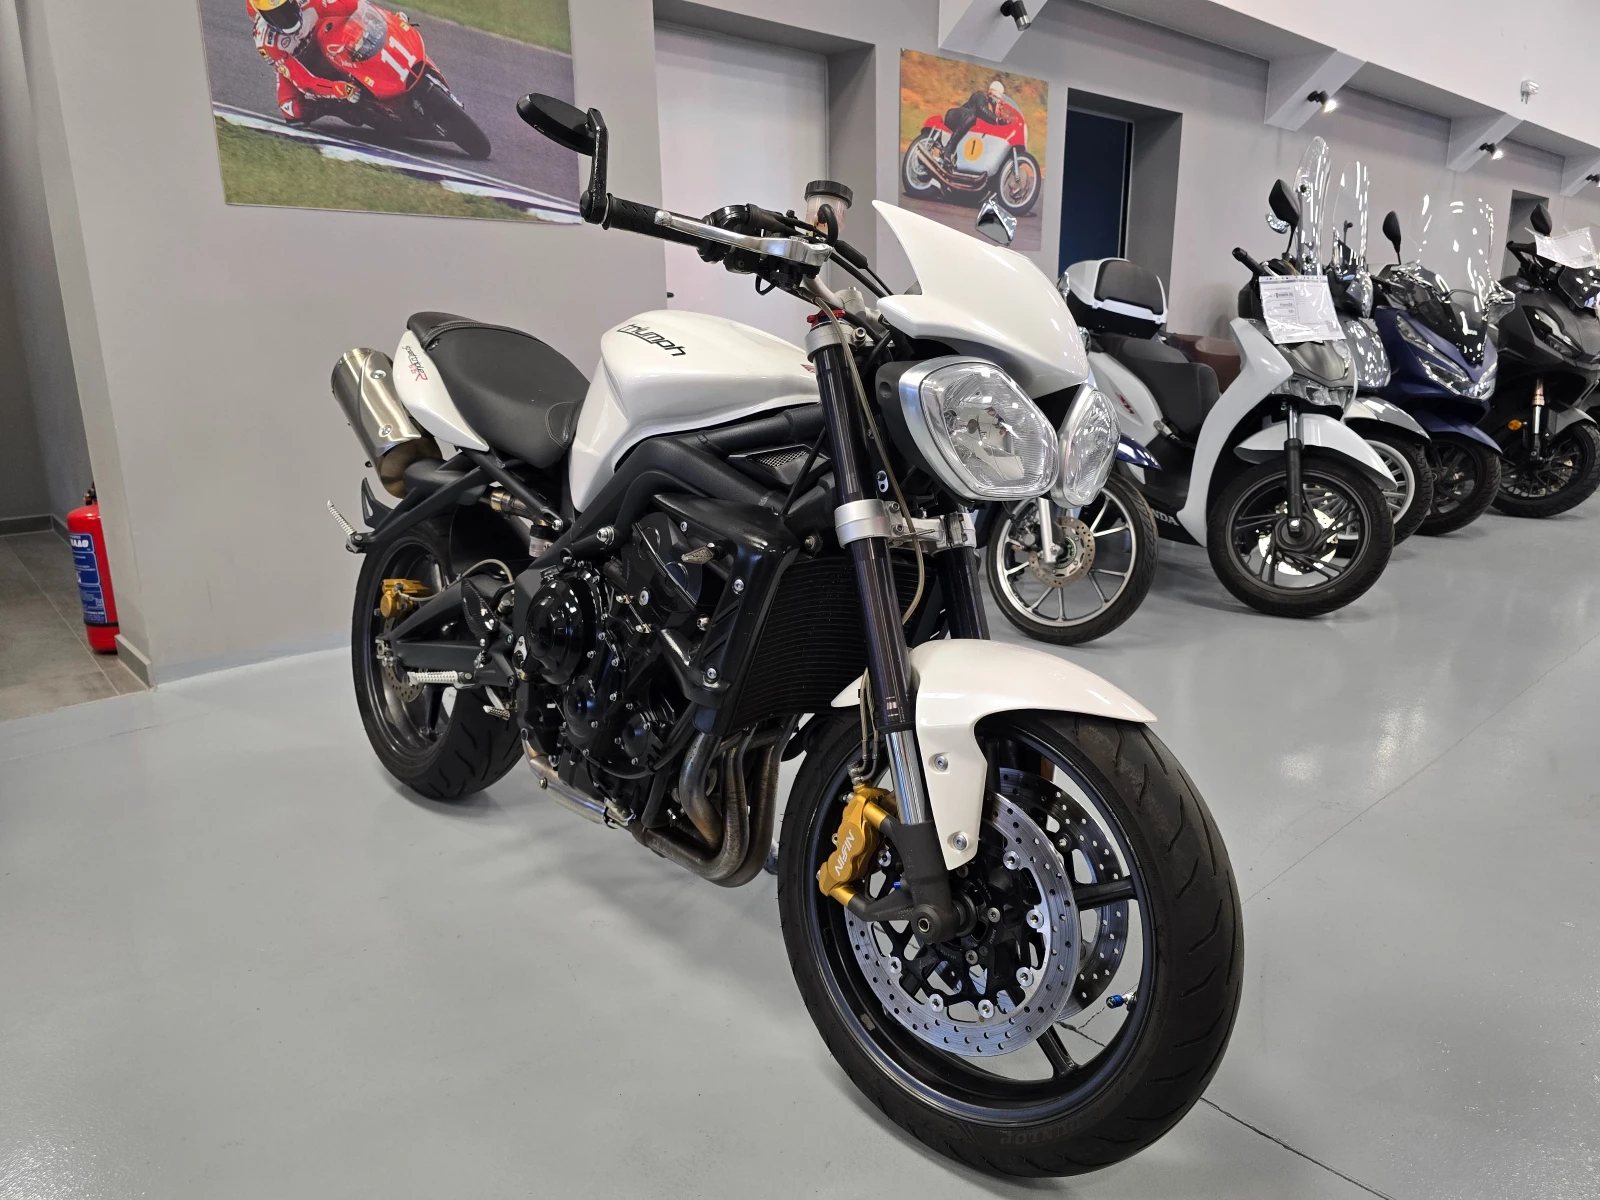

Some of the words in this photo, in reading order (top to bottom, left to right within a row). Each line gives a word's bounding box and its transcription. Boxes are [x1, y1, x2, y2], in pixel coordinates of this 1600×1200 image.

[381, 36, 417, 83] 11
[970, 140, 976, 155] 1
[617, 323, 686, 357] triumph
[1151, 508, 1180, 527] NDA
